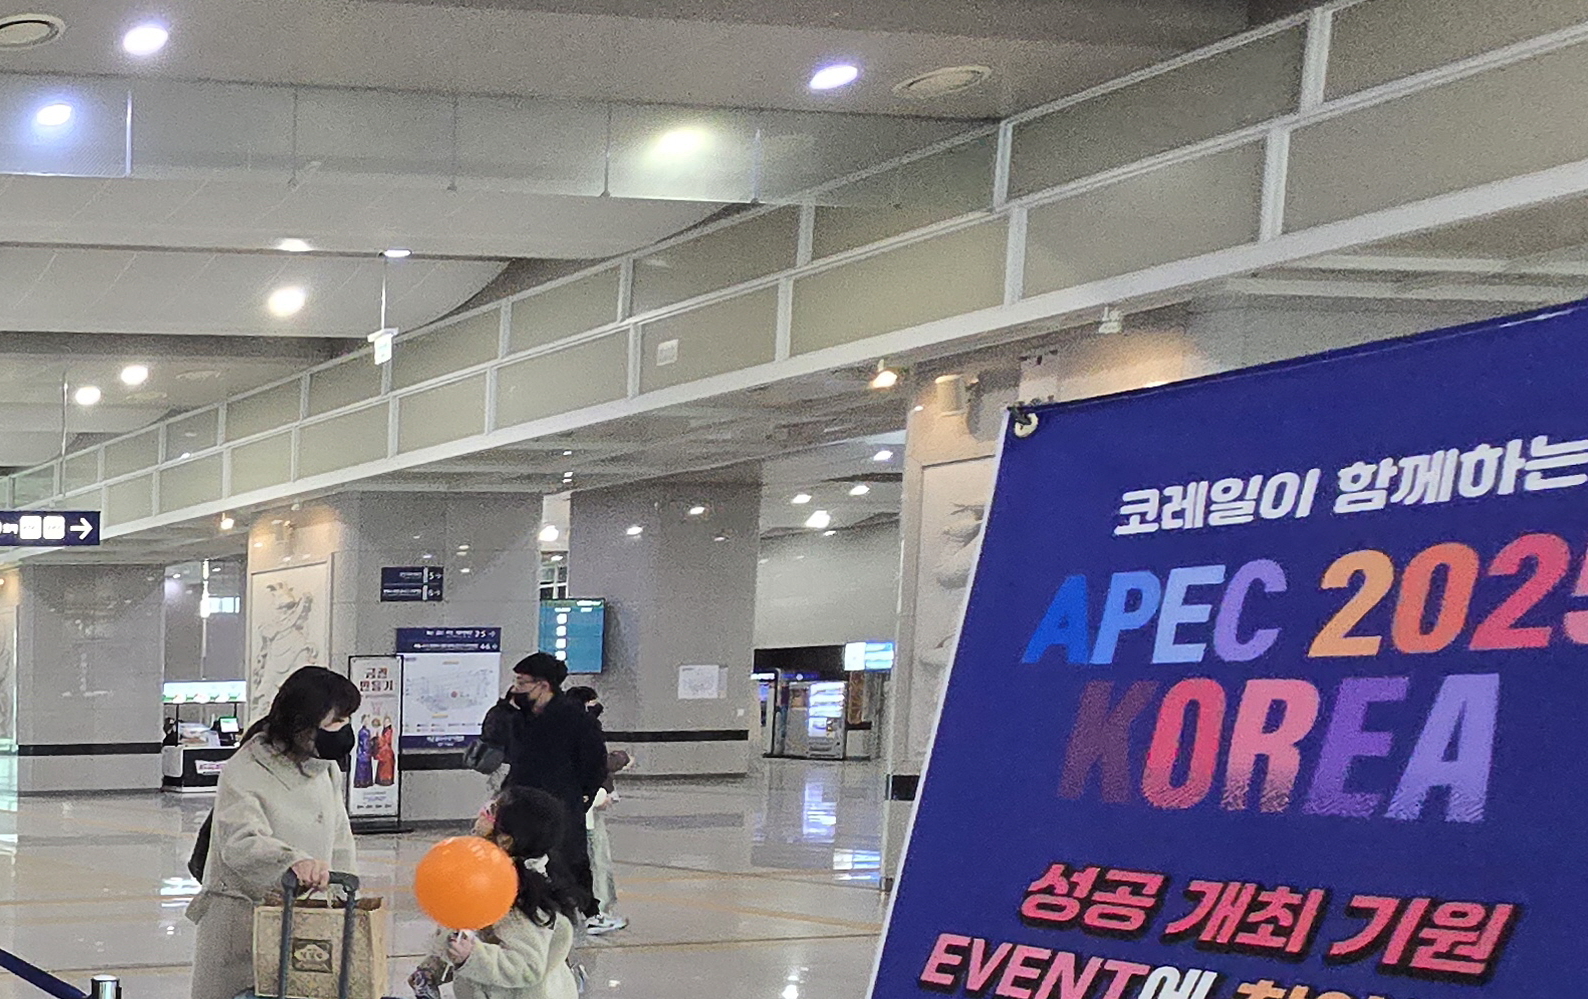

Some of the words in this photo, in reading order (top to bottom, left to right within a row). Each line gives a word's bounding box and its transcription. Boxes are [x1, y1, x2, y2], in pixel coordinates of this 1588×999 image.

[1114, 467, 1320, 536] 코레일이
[1333, 435, 1588, 514] 함께하는
[1021, 558, 1287, 665] APEC
[1308, 532, 1588, 659] 202
[359, 680, 394, 692] 만들기
[1058, 673, 1500, 824] KOREA
[1018, 862, 1167, 933] 성공
[1164, 878, 1323, 955] 개최
[1328, 893, 1514, 975] 기원
